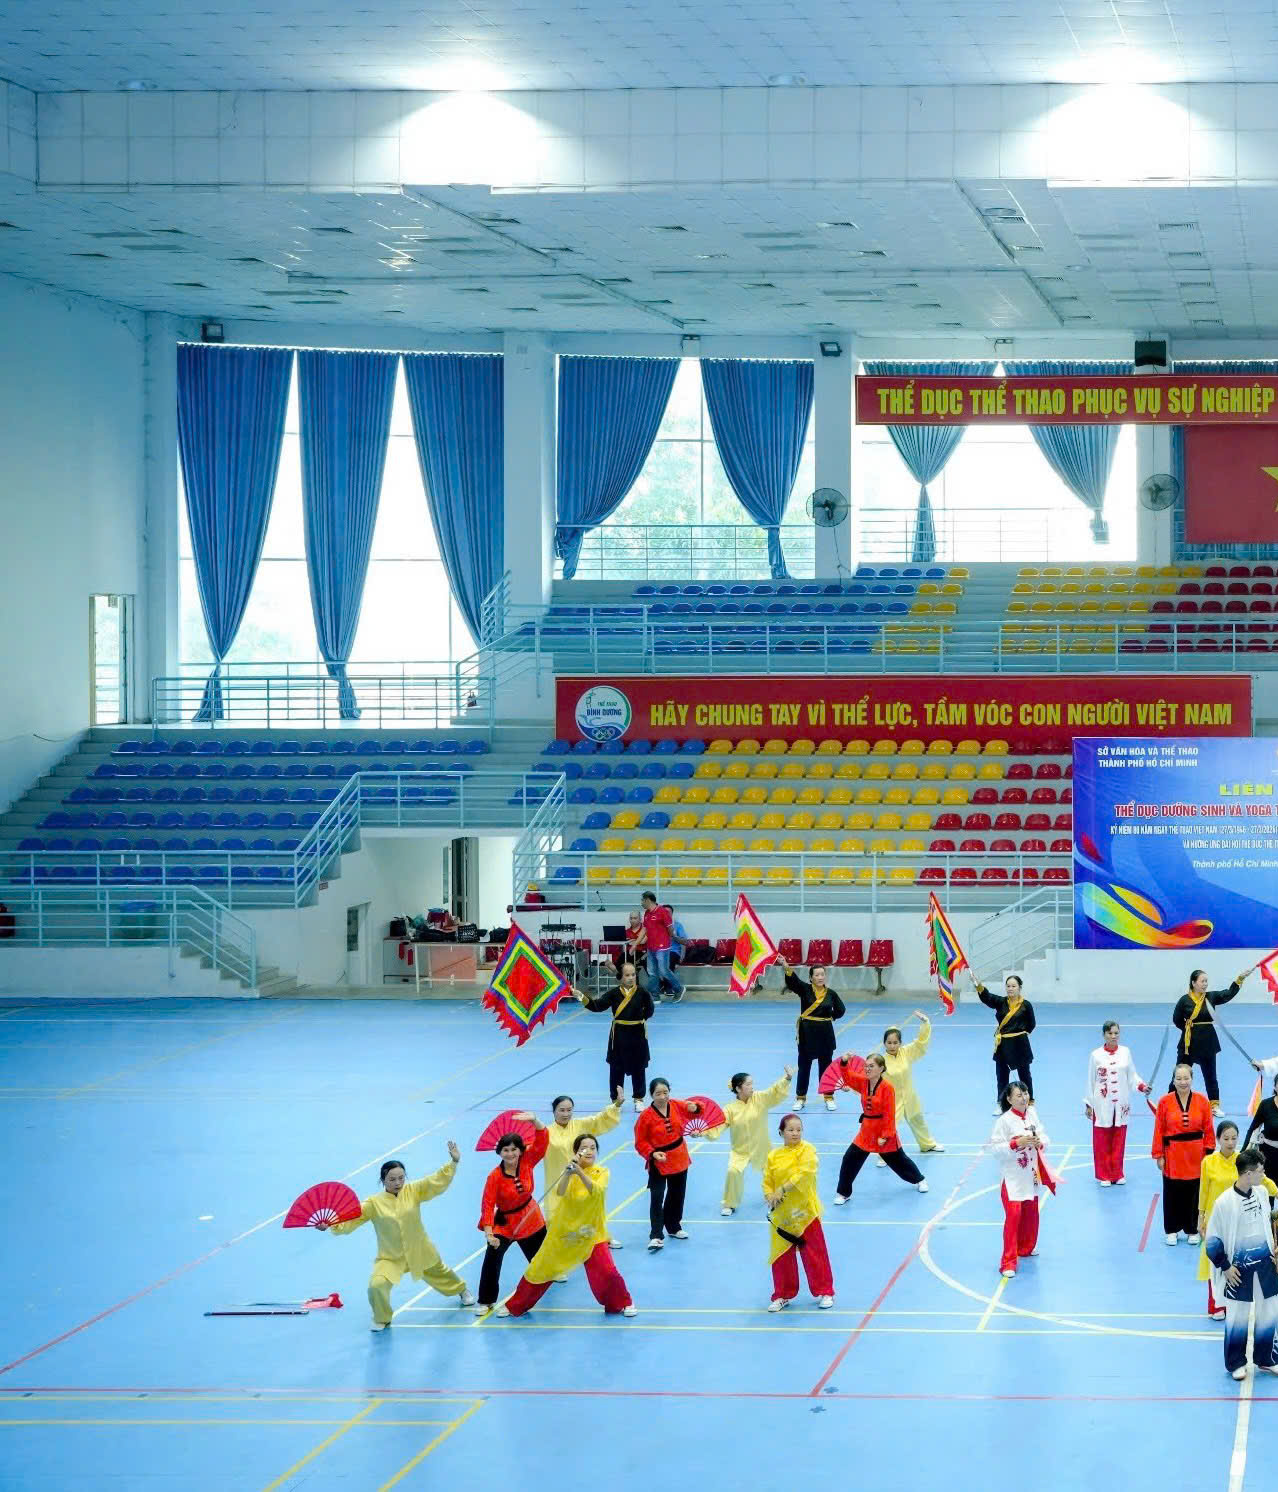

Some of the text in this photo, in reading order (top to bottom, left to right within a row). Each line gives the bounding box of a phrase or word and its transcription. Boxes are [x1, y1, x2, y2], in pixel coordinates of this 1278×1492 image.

[877, 380, 915, 415] THỂ
[921, 388, 963, 419] DỤC
[969, 380, 1007, 415] THỂ
[1013, 388, 1066, 415] THAO
[1072, 388, 1128, 419] PHỤC
[1134, 387, 1161, 418] VỤ
[1167, 384, 1197, 418] SỰ
[1201, 383, 1275, 418] NGHIỆP
[586, 708, 601, 716] BÌNH
[650, 695, 1232, 730] HÃY CHUNG TAY VÌ THỂ LỰC, TẦM VÓC CON NGƯỜI VIỆT NAM
[1097, 745, 1109, 756] SỞ
[1110, 746, 1127, 756] VĂN
[1147, 746, 1158, 756] VÀ
[1178, 747, 1198, 756] THAO
[1127, 757, 1144, 768] PHỐ
[1175, 759, 1197, 768] MINH
[1114, 800, 1136, 818] THỂ
[1137, 804, 1159, 820] DỤC
[1161, 802, 1197, 818] DƯỠNG
[1200, 804, 1226, 817] SINH
[1229, 802, 1242, 817] VÀ
[1246, 804, 1272, 817] YOGA
